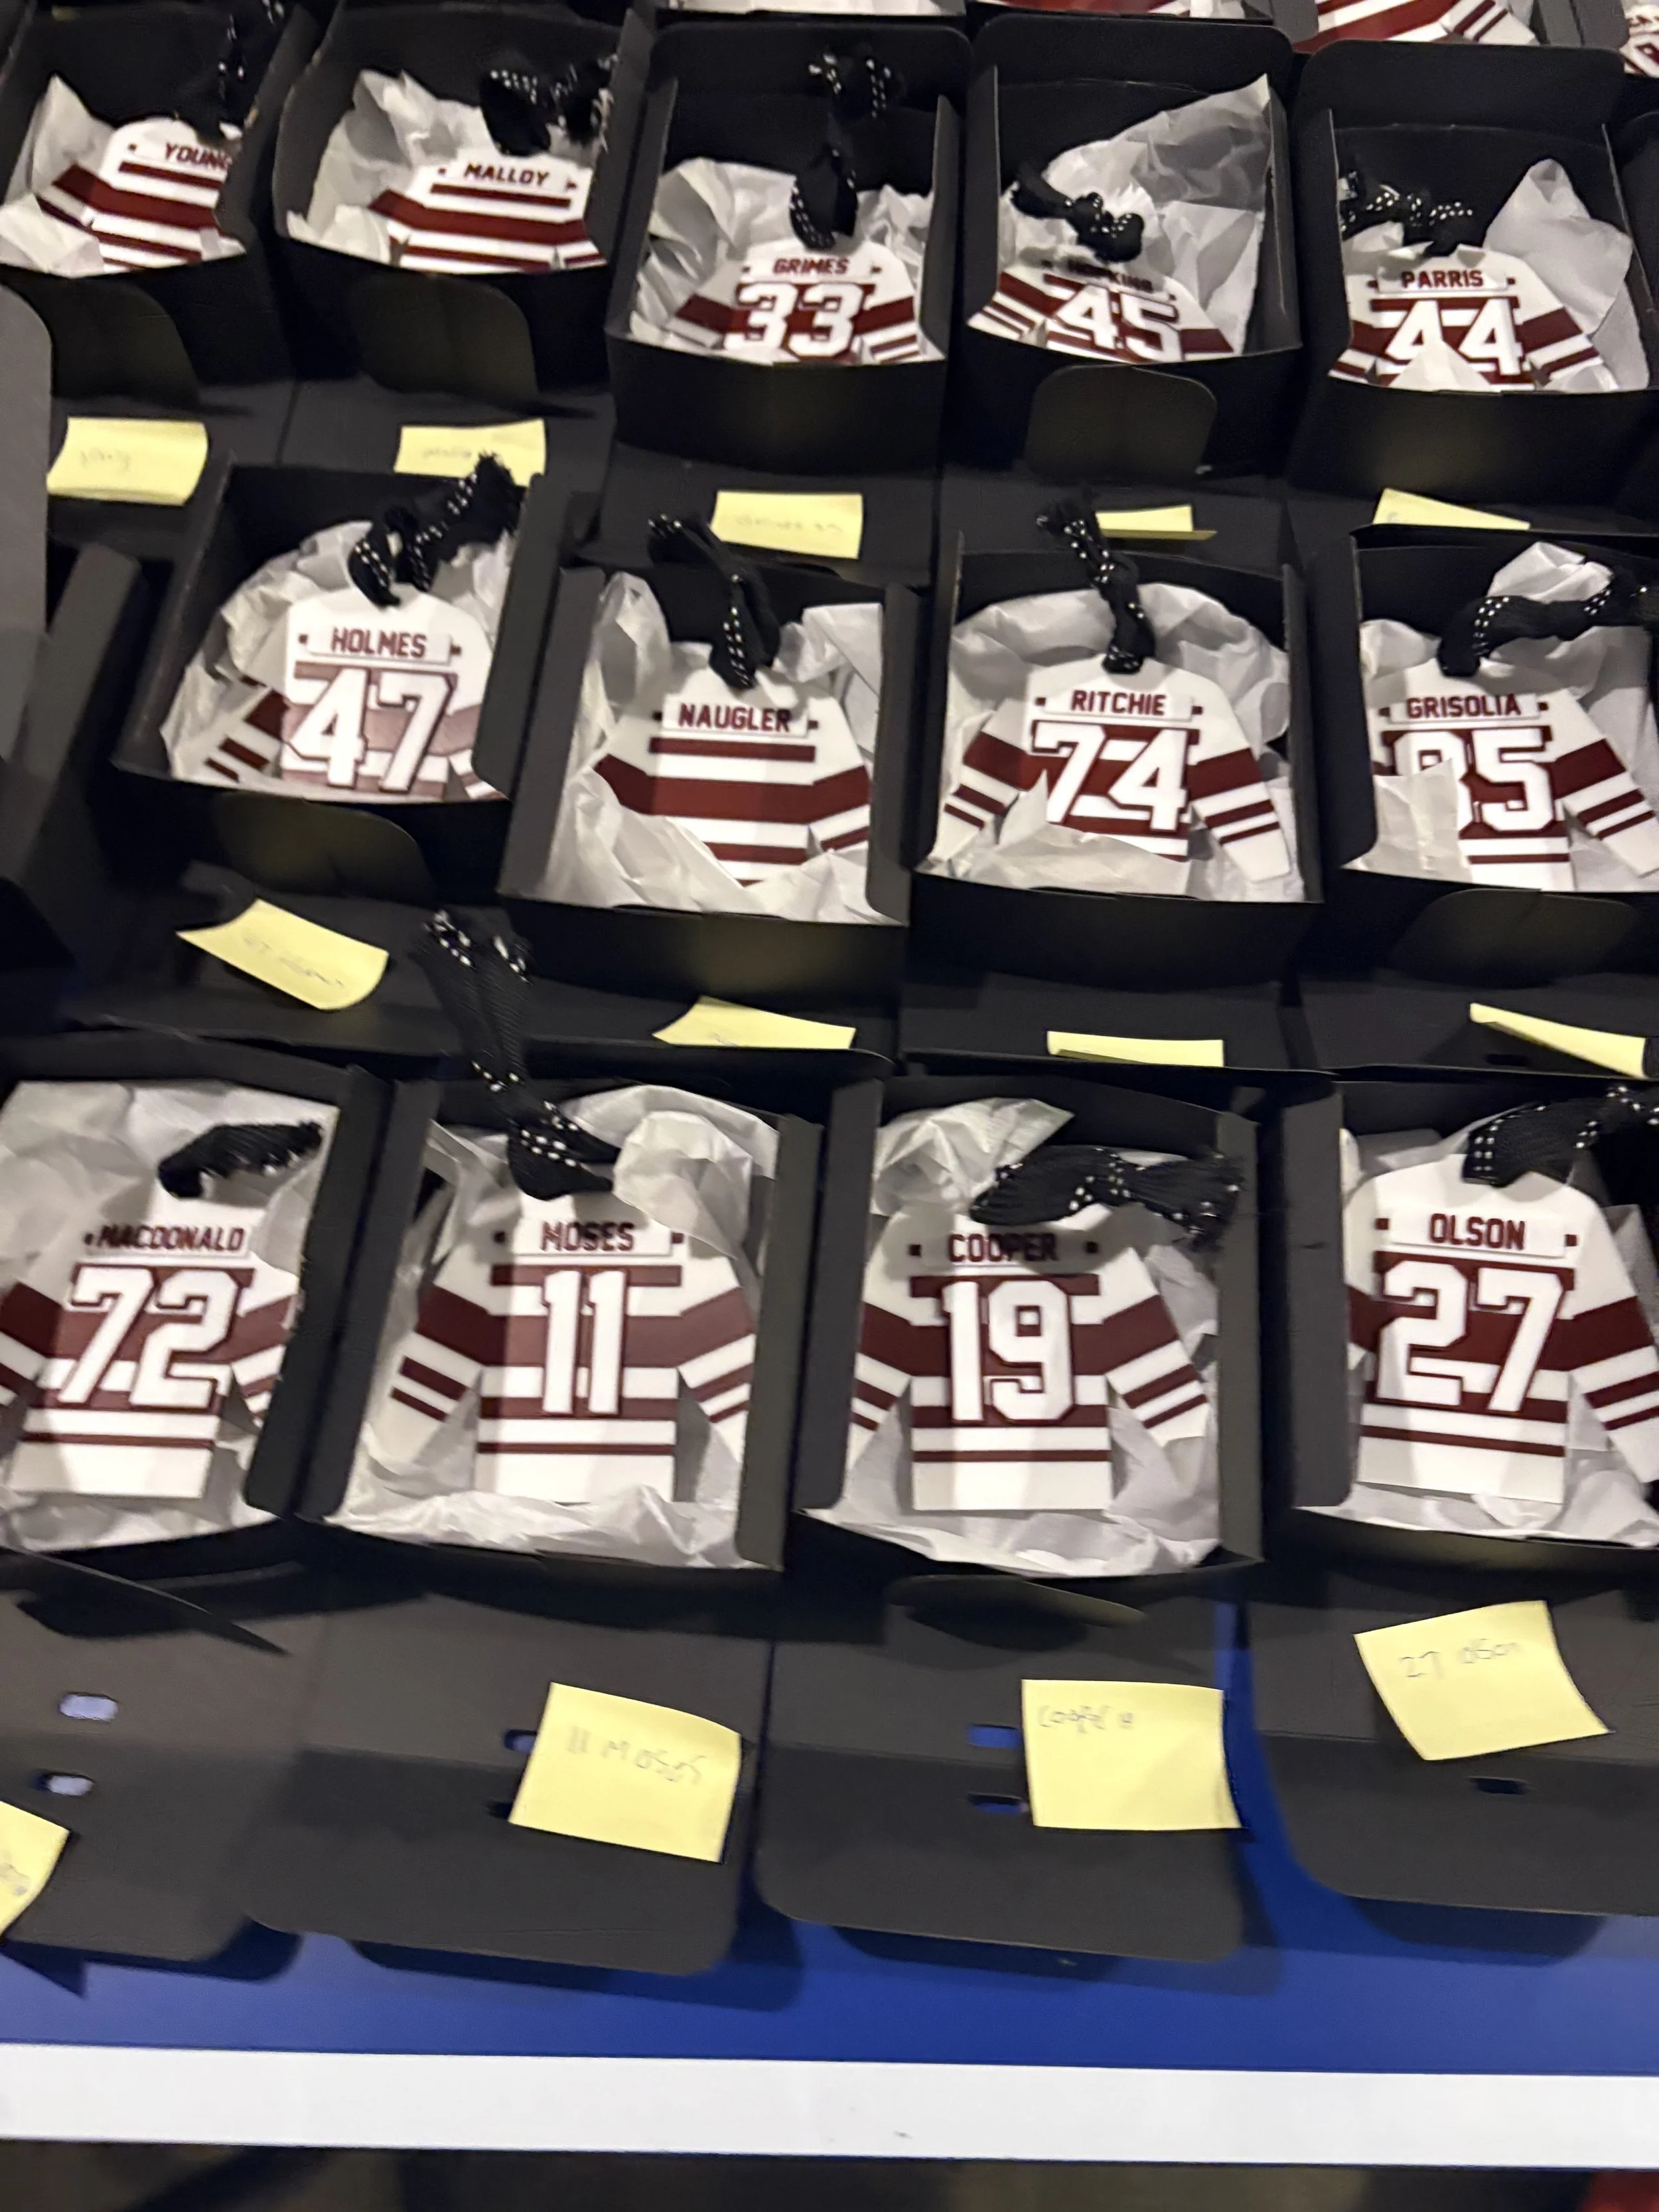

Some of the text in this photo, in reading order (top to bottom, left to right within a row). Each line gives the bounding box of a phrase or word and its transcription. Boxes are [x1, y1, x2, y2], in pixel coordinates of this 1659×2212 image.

[464, 163, 549, 186] MALLOY
[773, 258, 849, 275] GRIMES
[1401, 269, 1484, 288] PARRIS
[723, 282, 863, 358] 33
[1055, 283, 1180, 362] 45
[1384, 297, 1524, 376] 44
[332, 627, 427, 658] HOLMES
[678, 703, 791, 733] NAUGLER
[1070, 690, 1166, 716] RITCHIE
[1406, 694, 1520, 718] GRISOLIA
[289, 666, 455, 793] 47
[1031, 720, 1190, 834] 74
[98, 1225, 245, 1251] MACDONALD
[540, 1221, 635, 1251] MOSES
[949, 1233, 1059, 1262] COOPER
[1428, 1213, 1526, 1250] OLSON
[56, 1264, 242, 1410] 72
[541, 1268, 628, 1417] 11
[940, 1279, 1074, 1425] 19
[1375, 1259, 1565, 1412] 27
